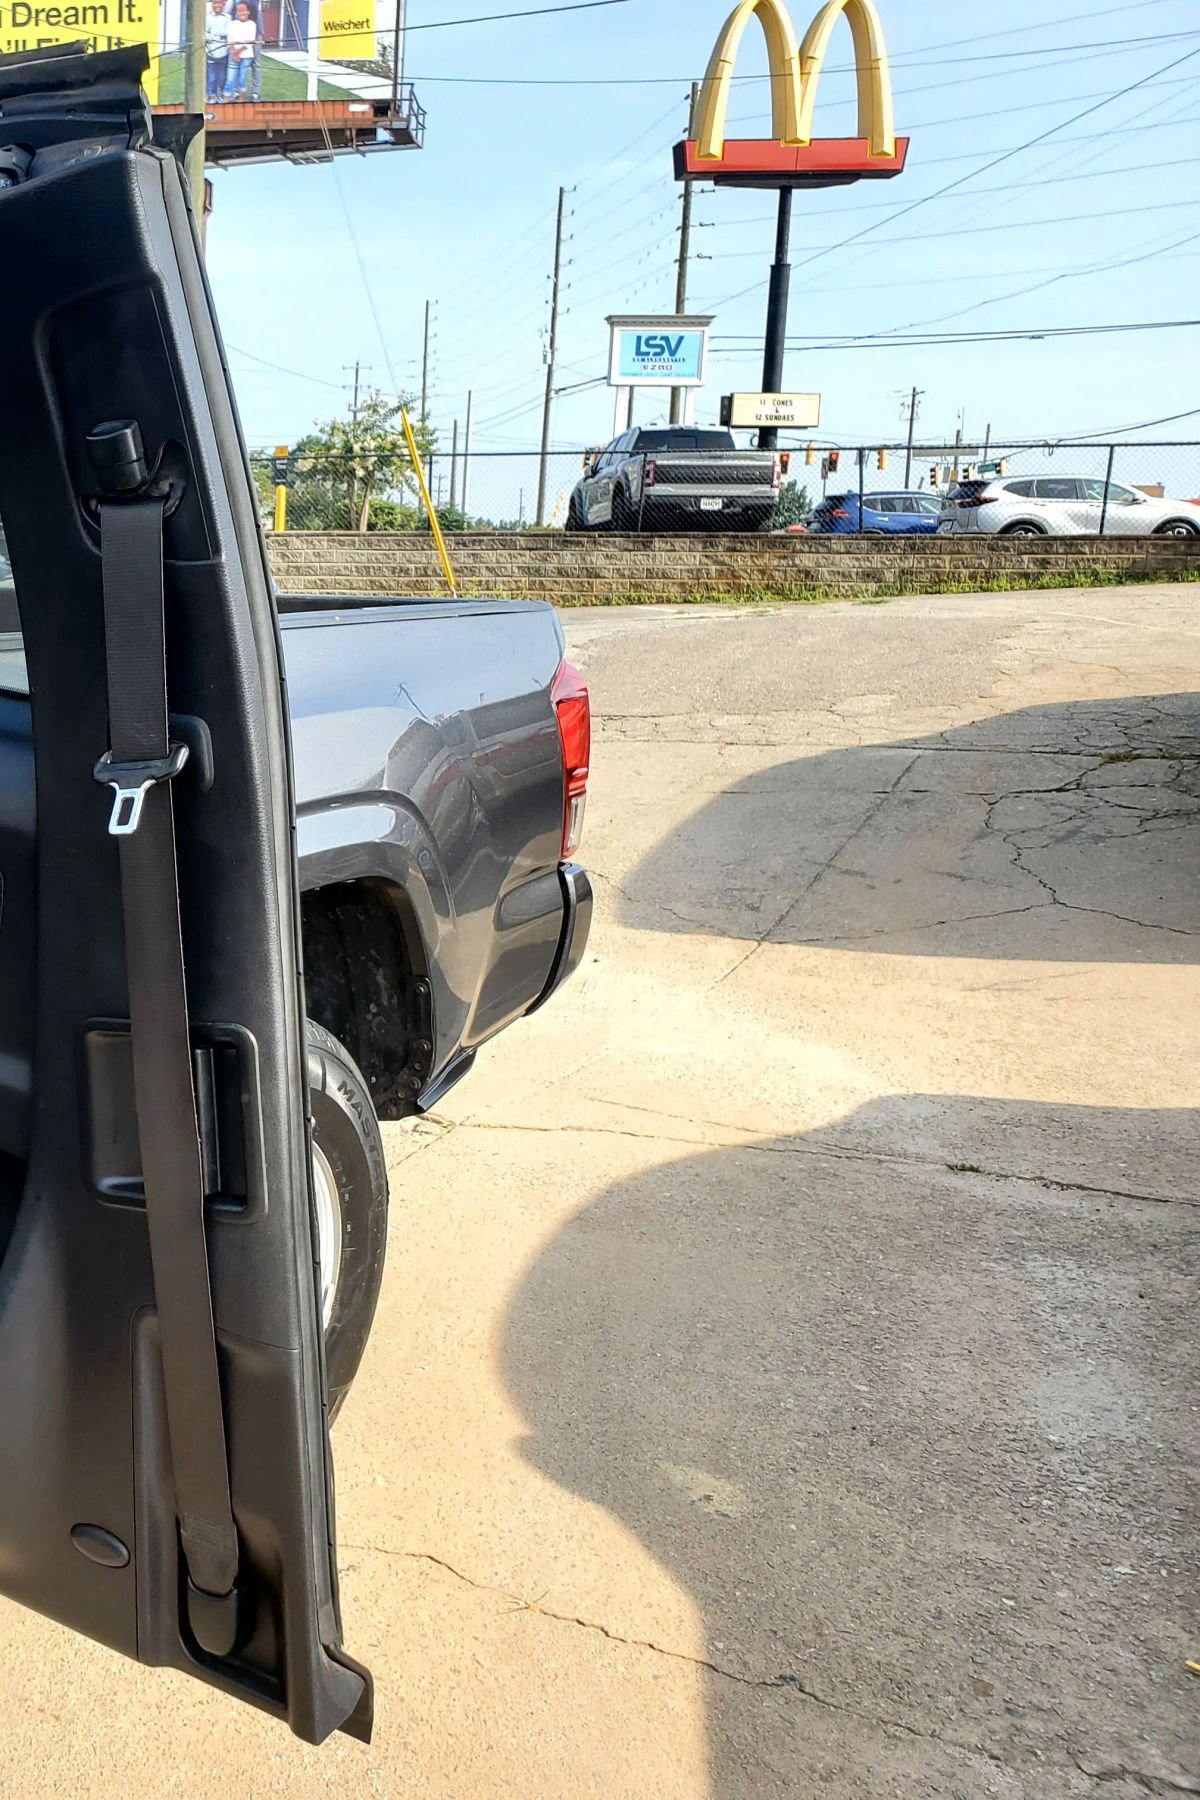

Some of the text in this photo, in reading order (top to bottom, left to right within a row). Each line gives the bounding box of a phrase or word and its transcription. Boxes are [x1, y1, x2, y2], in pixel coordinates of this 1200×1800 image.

[11, 1, 109, 29] Dream
[118, 0, 144, 24] It.
[323, 17, 371, 32] Weichert
[634, 335, 686, 357] LSV
[772, 399, 794, 407] CONES
[765, 414, 795, 422] SUNDAES
